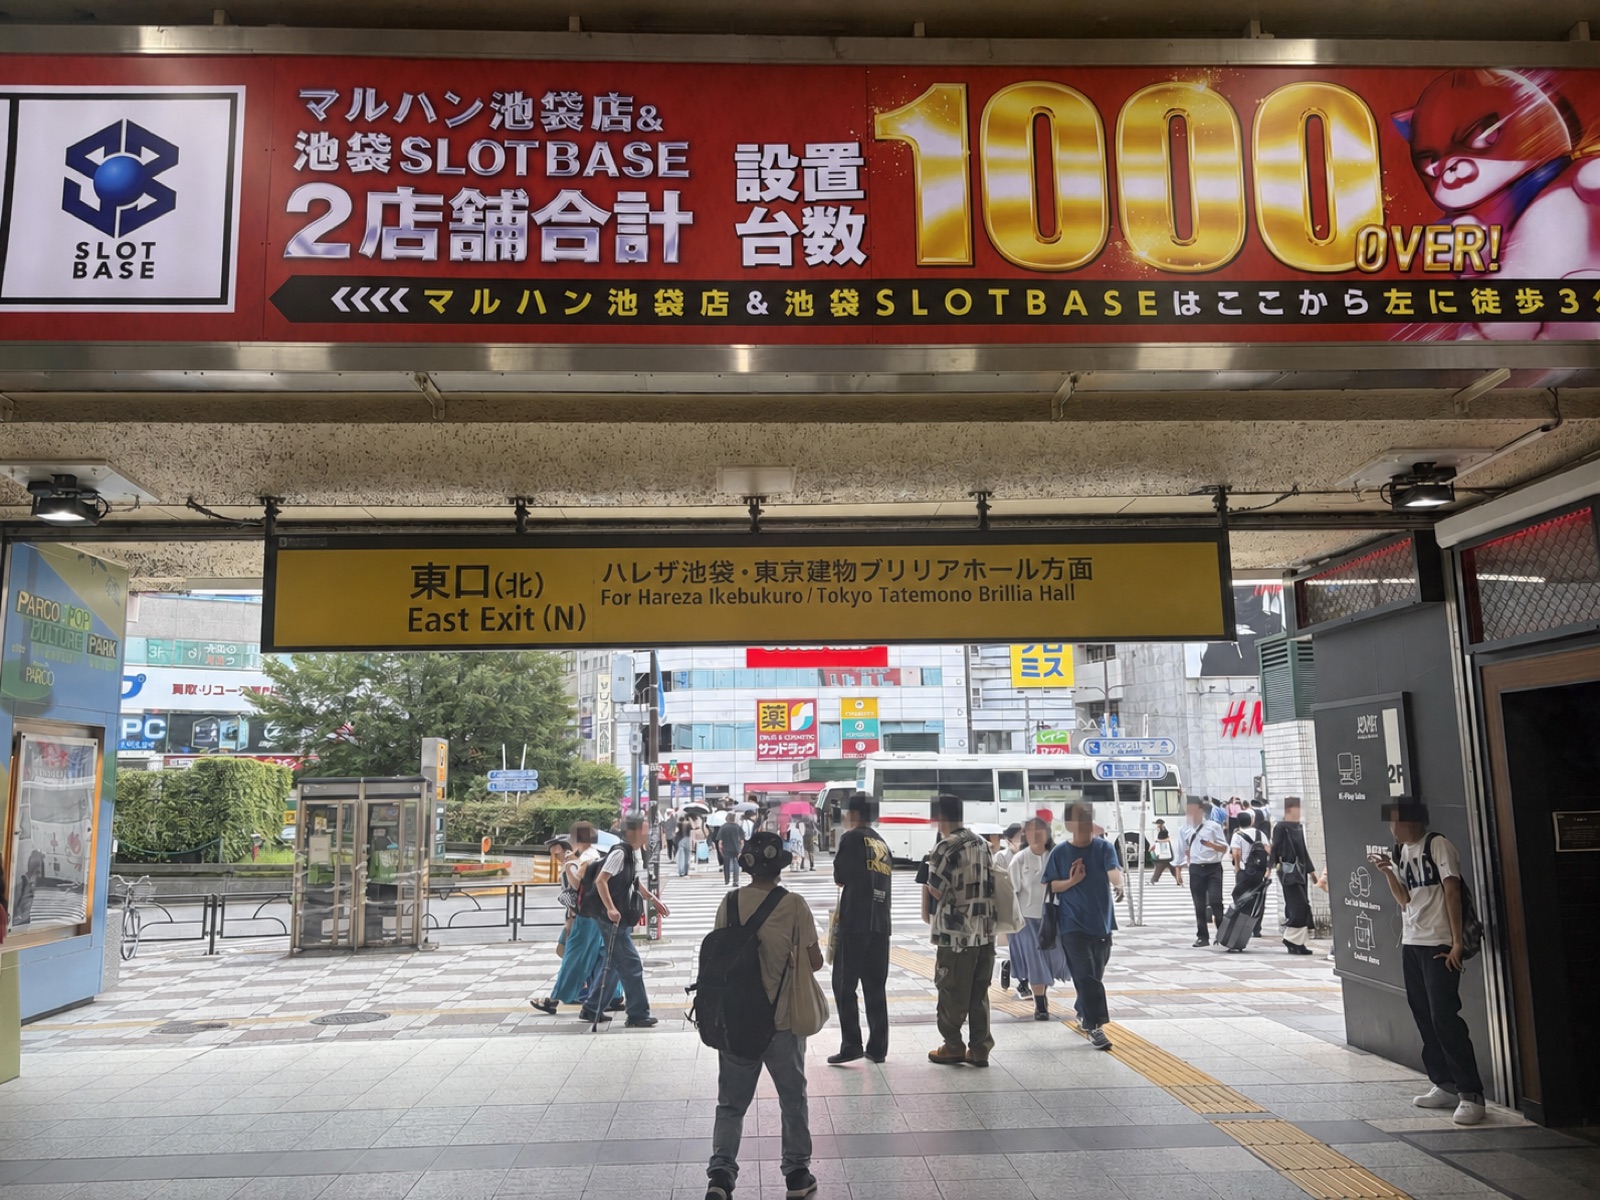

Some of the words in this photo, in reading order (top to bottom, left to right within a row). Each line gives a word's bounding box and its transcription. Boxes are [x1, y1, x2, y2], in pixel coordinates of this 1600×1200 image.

[735, 142, 866, 203] 設置
[874, 80, 1385, 273] 1000
[283, 182, 694, 264] 2店舗合計
[735, 205, 867, 268] 台数
[75, 241, 157, 261] SLOT
[1355, 223, 1502, 273] OVER!
[72, 260, 156, 280] BASE
[410, 561, 544, 600] 東口(北)
[601, 556, 1094, 585] ハレザ池袋・東京建物ブリリアホール方面
[17, 591, 60, 622] PARCO
[600, 589, 633, 606] For
[638, 588, 703, 605] Hareza
[878, 585, 972, 603] Tatemono
[979, 584, 1033, 602] Brillia
[1039, 584, 1076, 602] Hall
[408, 606, 469, 632] East
[480, 604, 535, 631] Exit
[544, 604, 587, 632] (N)
[87, 635, 117, 657] PARK
[26, 667, 55, 686] PARCO
[1021, 657, 1064, 678] ミス
[122, 718, 167, 740] PC
[761, 704, 786, 729] 薬
